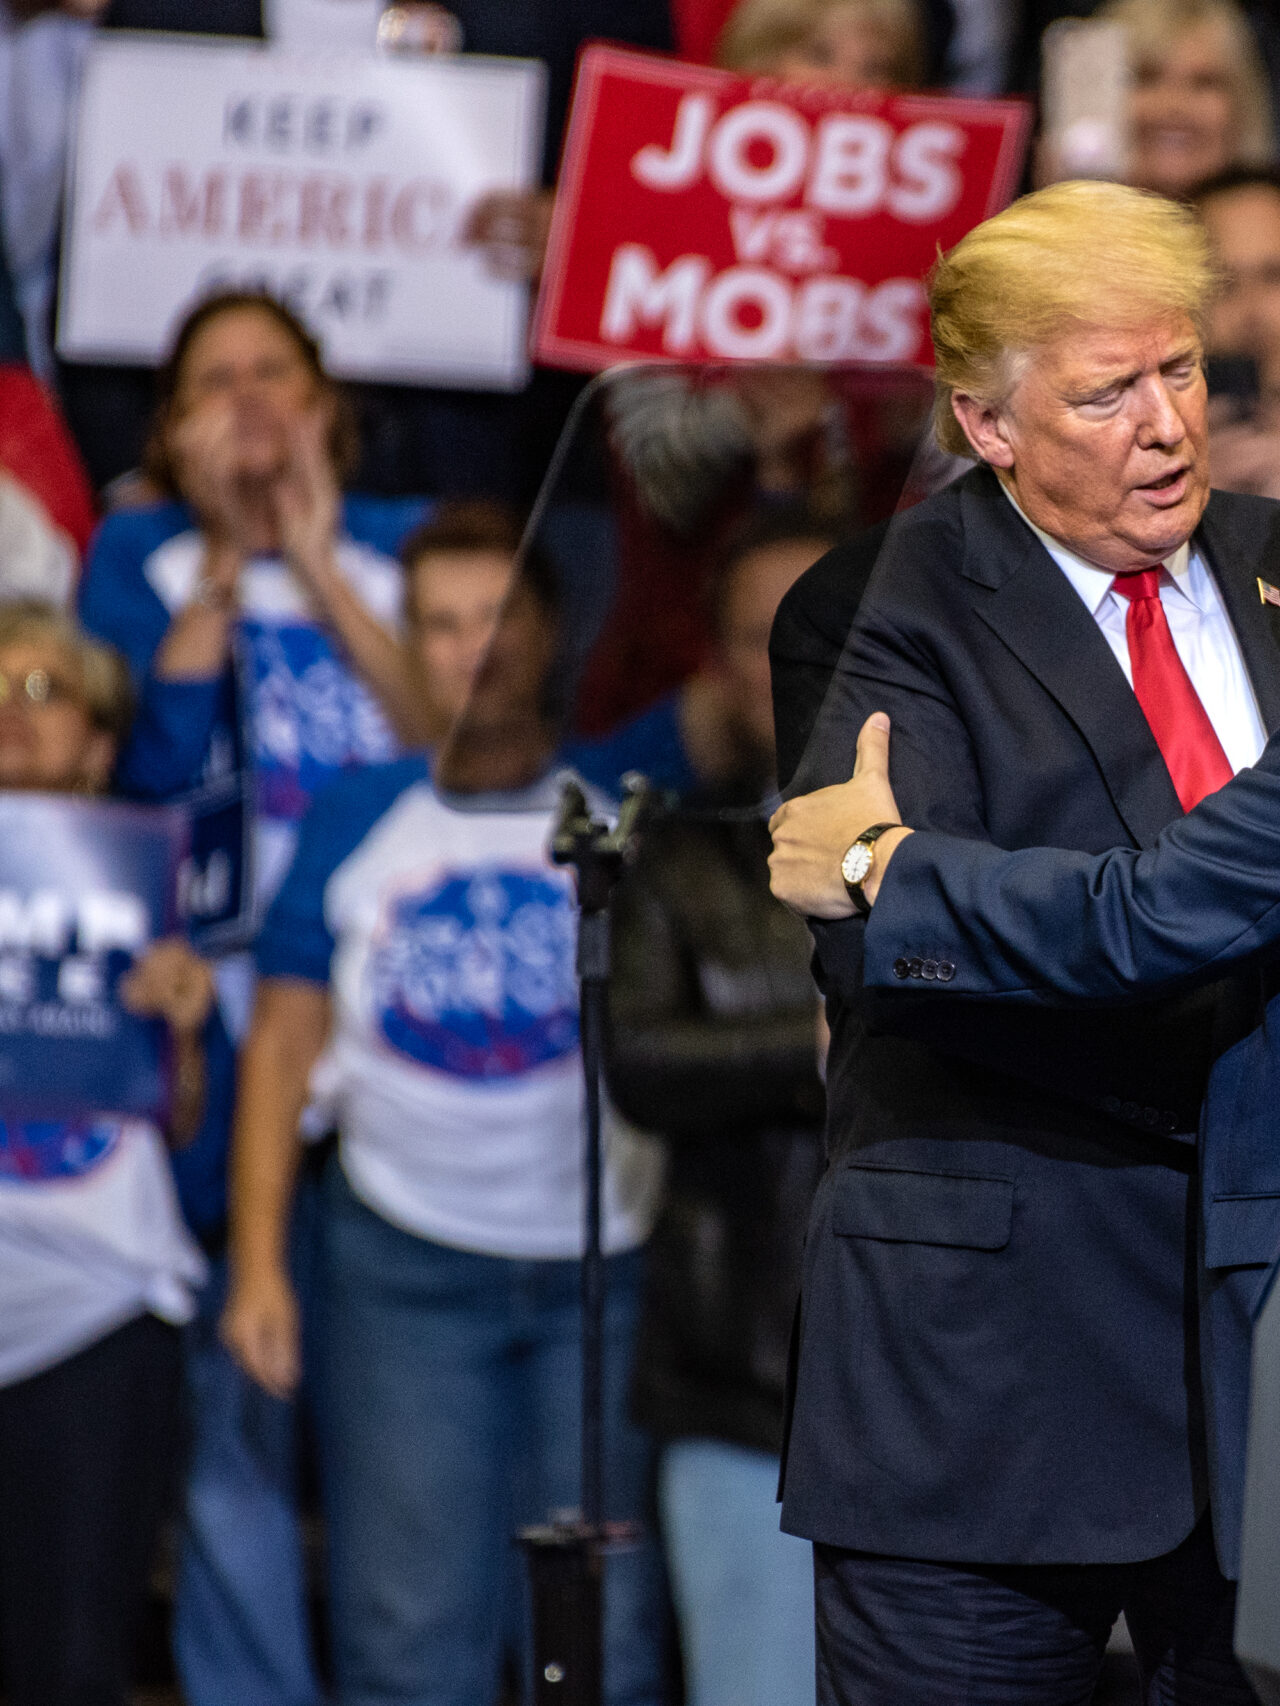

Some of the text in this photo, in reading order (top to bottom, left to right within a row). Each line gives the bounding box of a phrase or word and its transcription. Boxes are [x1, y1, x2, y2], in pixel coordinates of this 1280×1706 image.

[223, 93, 386, 152] KEEP
[630, 92, 969, 224] JOBS
[95, 161, 462, 257] AMERIC
[730, 205, 841, 275] VS.
[601, 243, 929, 361] MOBS
